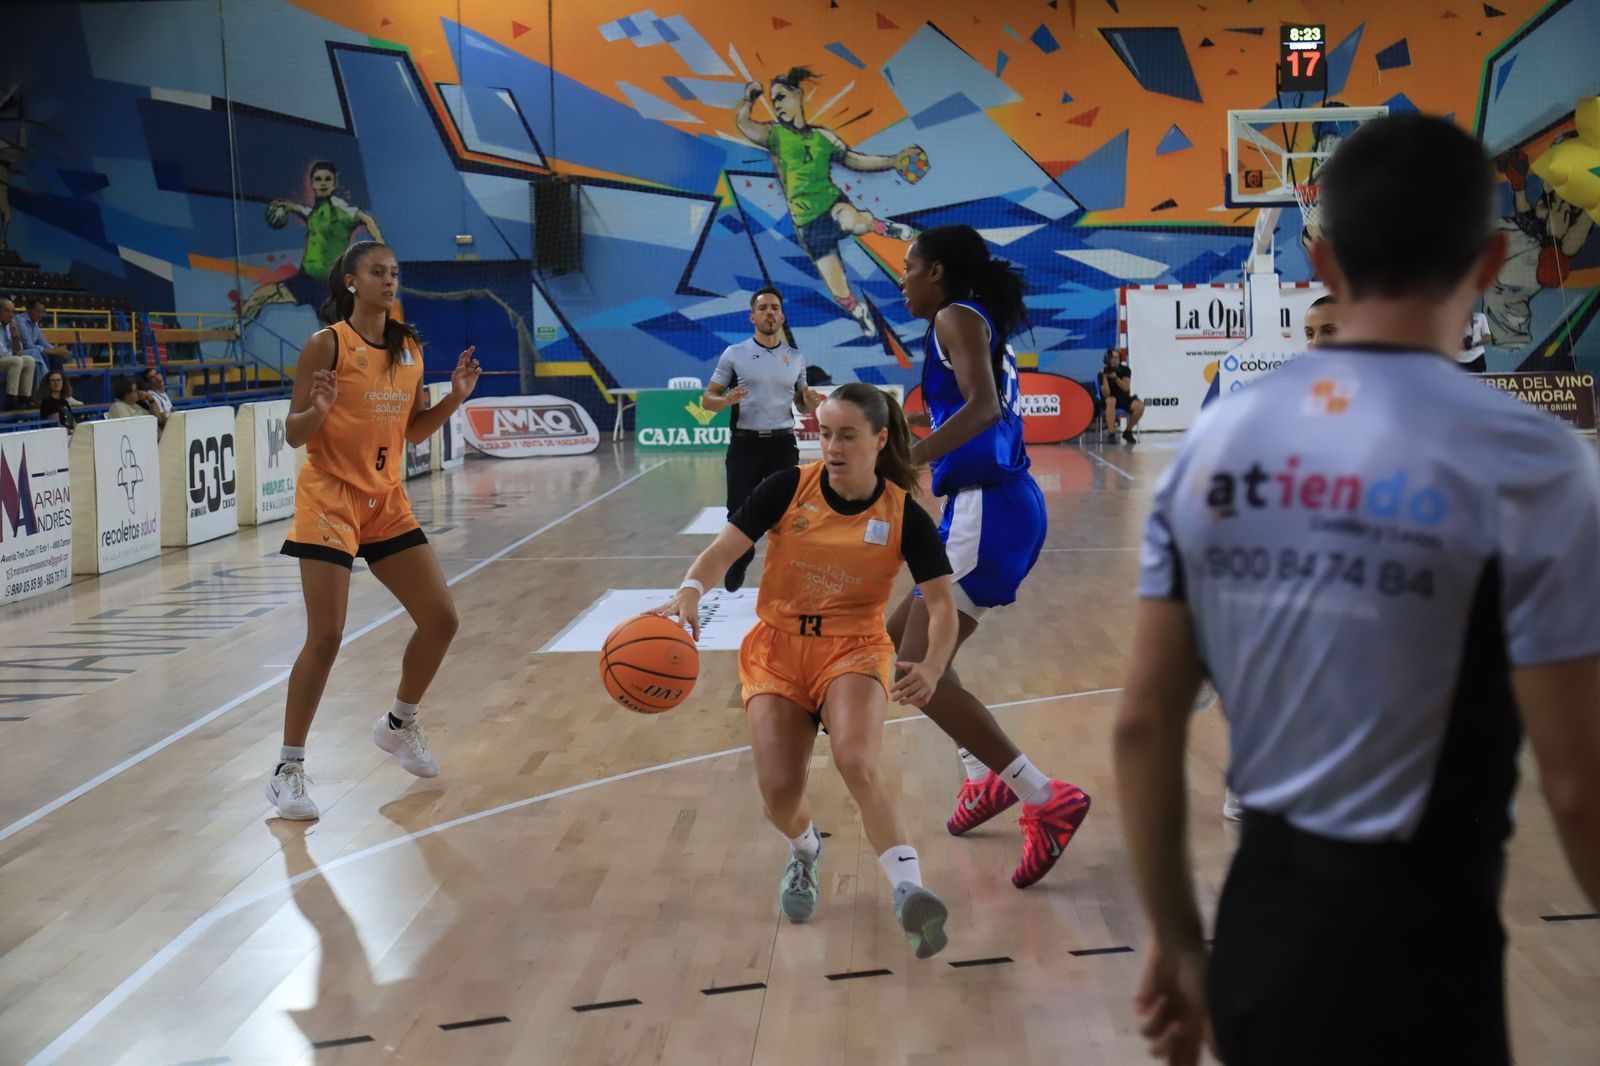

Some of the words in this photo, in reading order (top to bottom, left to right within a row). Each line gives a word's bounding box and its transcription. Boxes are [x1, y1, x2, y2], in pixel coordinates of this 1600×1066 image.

[1290, 27, 1321, 41] 8:23
[1286, 51, 1321, 77] 17
[1175, 301, 1200, 330] La
[1522, 376, 1553, 389] DEL
[1555, 374, 1594, 388] VINO
[364, 389, 412, 401] recoletas
[375, 400, 402, 413] salud
[1030, 404, 1059, 414] LEÓN
[1551, 403, 1577, 411] ORIGEN
[483, 407, 577, 437] AMAQ
[638, 426, 692, 446] CAJA
[375, 447, 388, 471] 5
[34, 486, 71, 510] ARIAN
[1207, 454, 1448, 526] atiendo
[101, 518, 139, 548] recoletas
[1206, 545, 1270, 581] 900
[799, 614, 824, 637] 13
